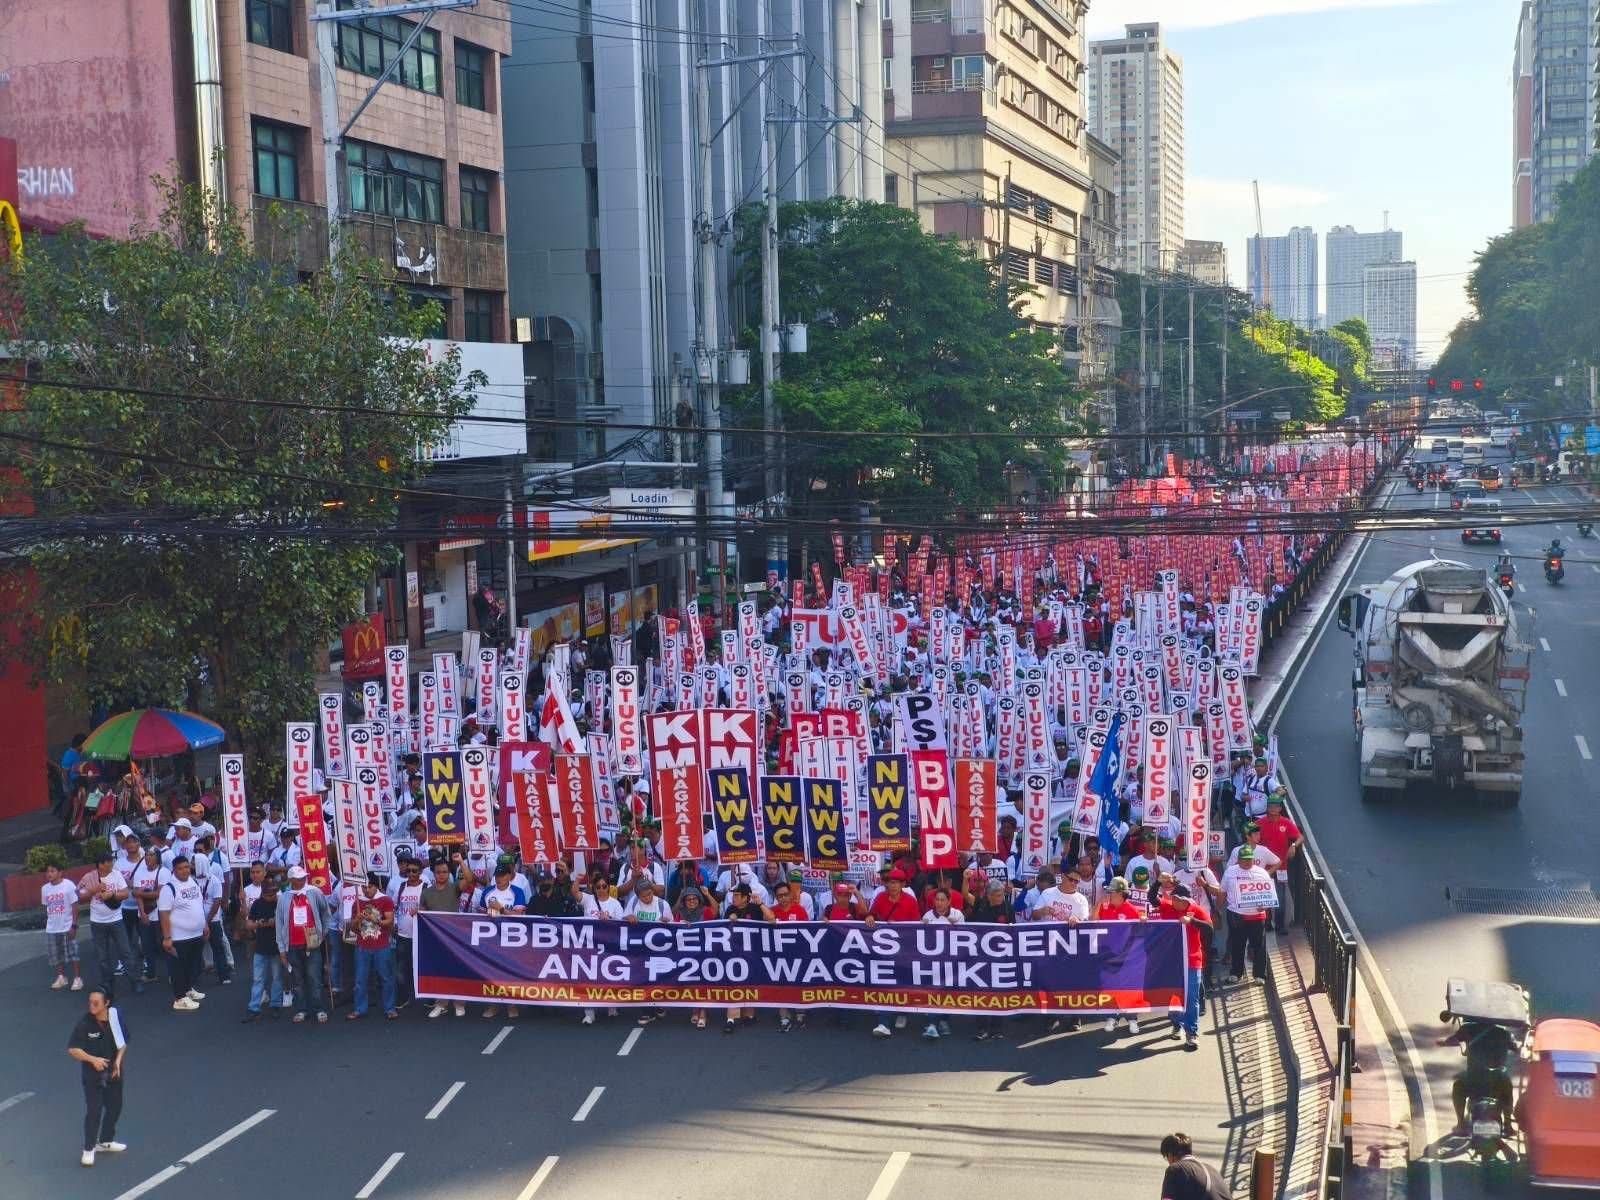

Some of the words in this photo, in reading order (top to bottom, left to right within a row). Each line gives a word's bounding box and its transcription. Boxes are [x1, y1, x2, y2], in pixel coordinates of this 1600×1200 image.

[1167, 583, 1177, 623] TUCP
[793, 614, 907, 644] TUP
[847, 620, 868, 661] TUCP
[934, 620, 942, 656] TUCP
[1219, 617, 1228, 652] TUCP
[1245, 614, 1257, 657] TUCP
[392, 664, 404, 712] TUCP
[481, 663, 493, 706] TUCP
[506, 679, 518, 688] 20
[618, 674, 632, 682] 20
[754, 652, 765, 694] TUCP
[1003, 647, 1012, 688] TUCP
[1166, 648, 1180, 688] TUCP
[424, 689, 434, 736] TUCP
[506, 693, 521, 742] TUC
[619, 689, 635, 750] TUCP
[1124, 692, 1136, 700] 20
[1148, 681, 1160, 713] TUC
[1174, 698, 1186, 706] 20
[1226, 683, 1245, 732] TUCP
[293, 730, 308, 740] 20
[327, 711, 341, 758] TUCP
[352, 732, 369, 742] 20
[652, 714, 696, 768] KM
[710, 713, 753, 769] KM
[907, 697, 936, 749] PS
[970, 698, 981, 748] TUCP
[1000, 712, 1011, 760] TUCP
[1029, 699, 1043, 750] TUCP
[1127, 720, 1140, 769] TUCP
[1152, 724, 1166, 733] 20
[1212, 718, 1225, 762] TUCP
[227, 762, 240, 772] 20
[360, 772, 376, 782] 20
[373, 738, 389, 790] TUCP
[468, 754, 482, 762] 20
[1150, 739, 1166, 801] TUCP
[1193, 766, 1208, 777] 20
[428, 758, 460, 830] NWC
[469, 768, 487, 829] TUCP
[567, 756, 588, 847] NAGKAISA
[871, 760, 904, 836] NWC
[969, 761, 985, 850] NAGKAISA
[1029, 778, 1045, 787] 20
[229, 778, 245, 840] TUCP
[364, 787, 381, 849] TUCP
[524, 773, 549, 862] NAGKAISA
[673, 768, 692, 857] NAGKAISA
[716, 774, 747, 847] NWC
[765, 783, 799, 849] NWC
[809, 784, 839, 856] NWC
[918, 760, 953, 865] BMP
[1029, 792, 1044, 852] TUCP
[1192, 783, 1205, 845] TUCP
[470, 921, 605, 954] PBBM,
[619, 926, 828, 954] I-CERTIFY
[840, 928, 900, 956] AS
[916, 928, 1108, 957] URGENT
[538, 954, 632, 982] ANG
[762, 957, 898, 984] WAGE
[912, 961, 1033, 988] HIKE!
[482, 984, 580, 1000] NATIONAL
[586, 987, 644, 1001] WAGE
[651, 988, 759, 1001] COALITION
[802, 990, 846, 1002] BMP
[864, 992, 908, 1006] KMU
[927, 992, 1036, 1008] NAGKAISA
[1056, 994, 1114, 1008] TUCP
[1562, 1081, 1592, 1097] 028
